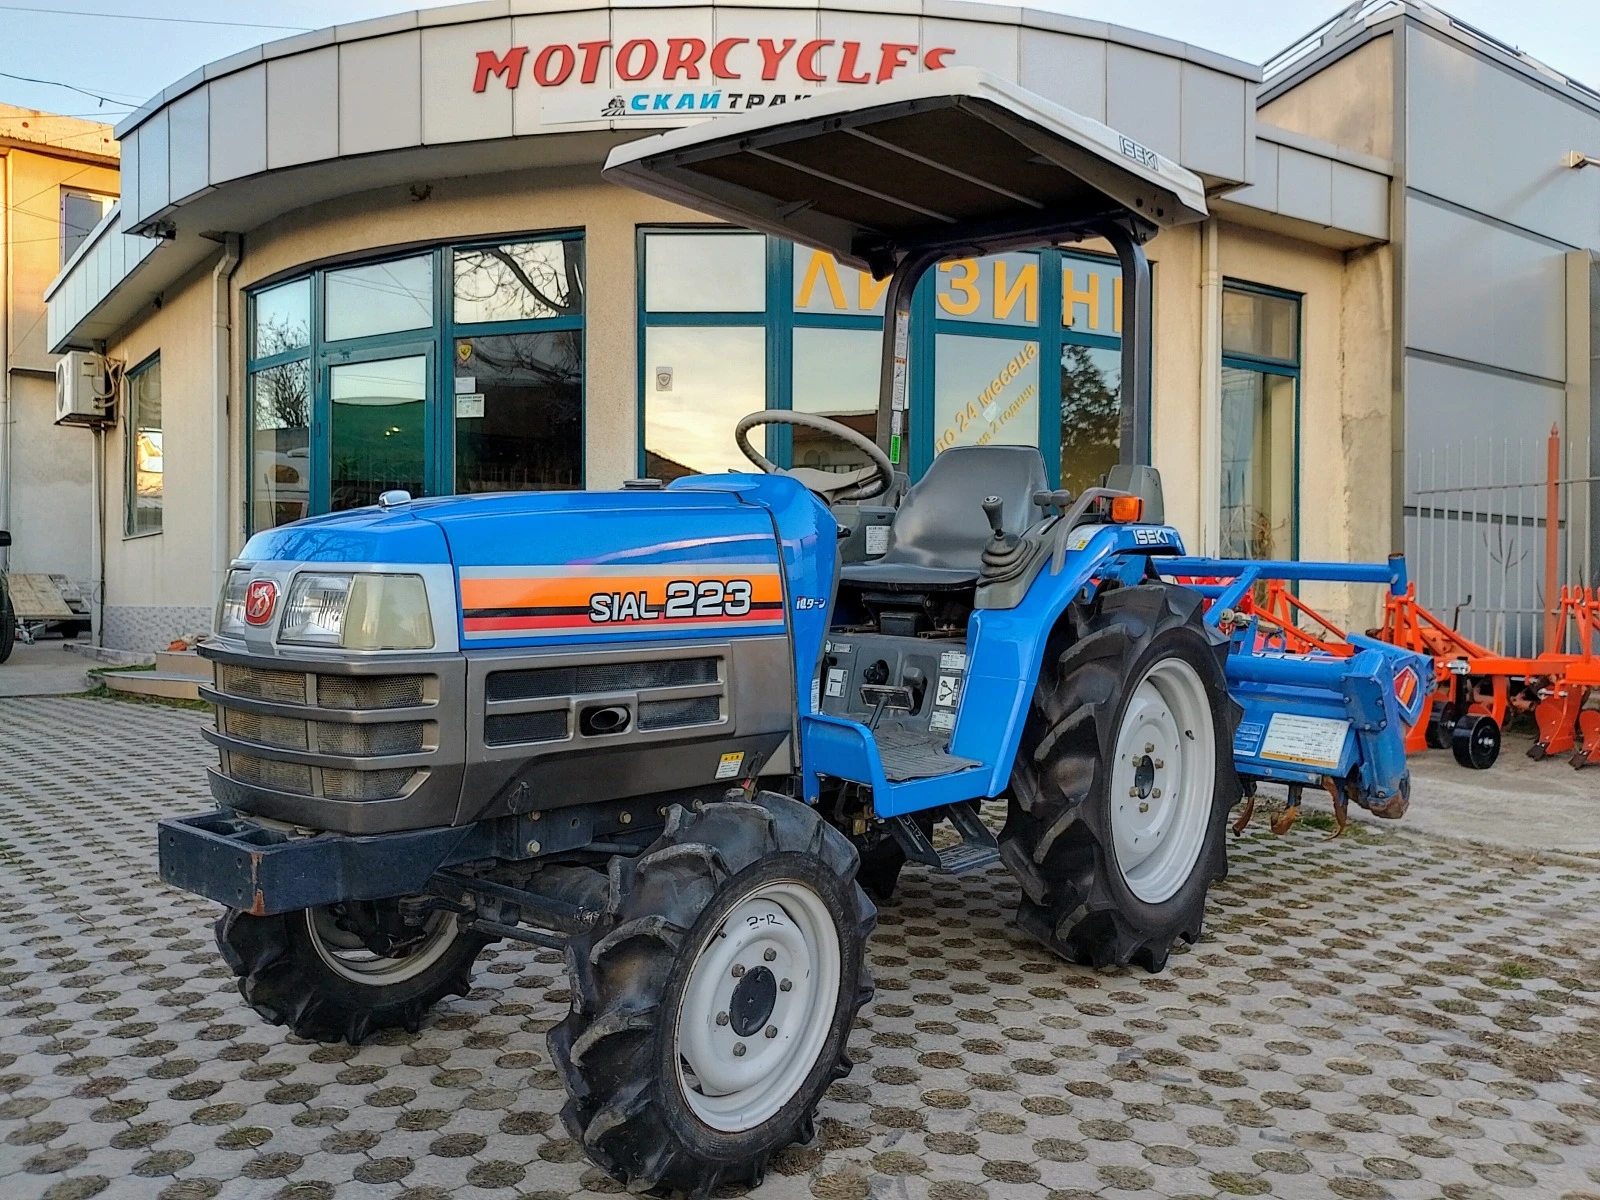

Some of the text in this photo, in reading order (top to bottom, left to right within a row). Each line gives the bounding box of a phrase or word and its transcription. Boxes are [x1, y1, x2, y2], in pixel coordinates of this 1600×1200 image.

[631, 90, 812, 110] СКАЙ ТРА
[1118, 135, 1159, 172] ISEKI
[955, 401, 978, 433] 24
[977, 342, 1038, 409] месеца
[1132, 529, 1171, 545] ISEKI
[589, 579, 752, 623] SIAL 223
